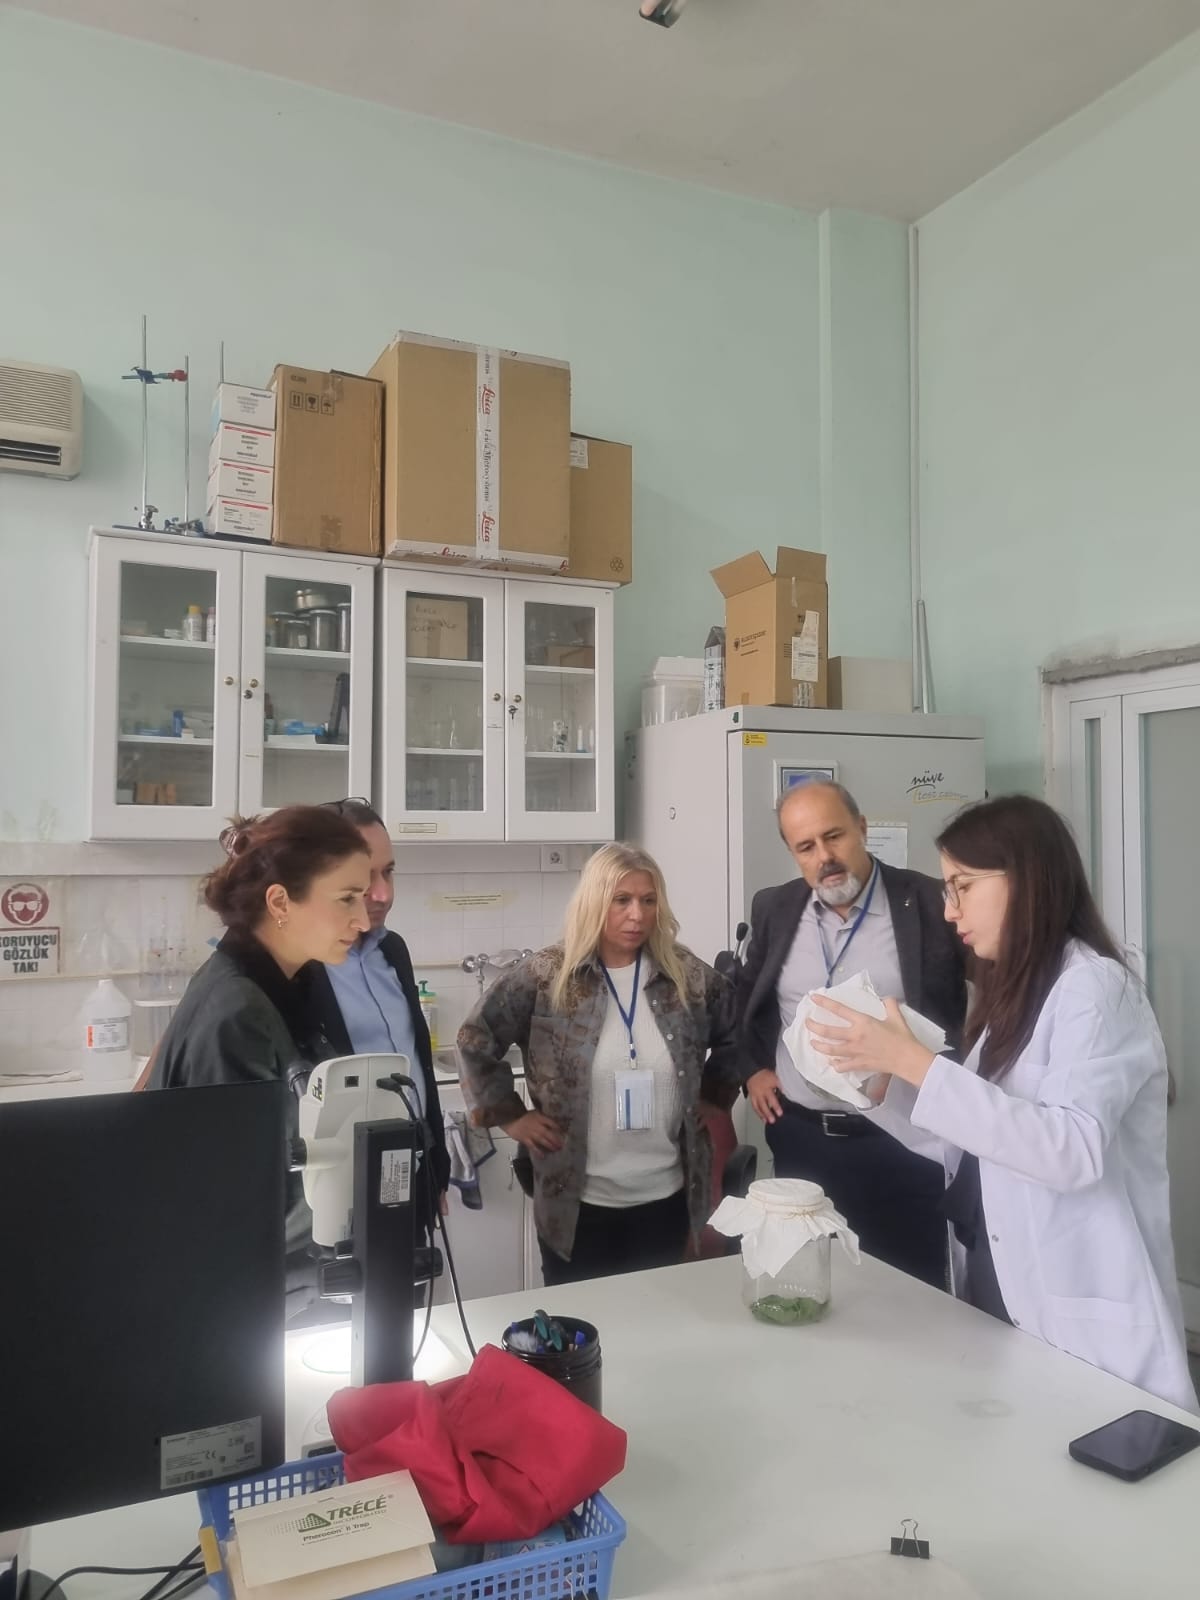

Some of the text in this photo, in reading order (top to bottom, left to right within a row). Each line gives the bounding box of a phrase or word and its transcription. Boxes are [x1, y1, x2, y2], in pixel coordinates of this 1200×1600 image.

[482, 384, 495, 415] Leica
[482, 511, 495, 542] Leica
[910, 770, 944, 785] nüve
[4, 946, 48, 960] GÖZLÜK
[13, 962, 38, 973] TAK!
[327, 1494, 387, 1521] TRÉCÉ
